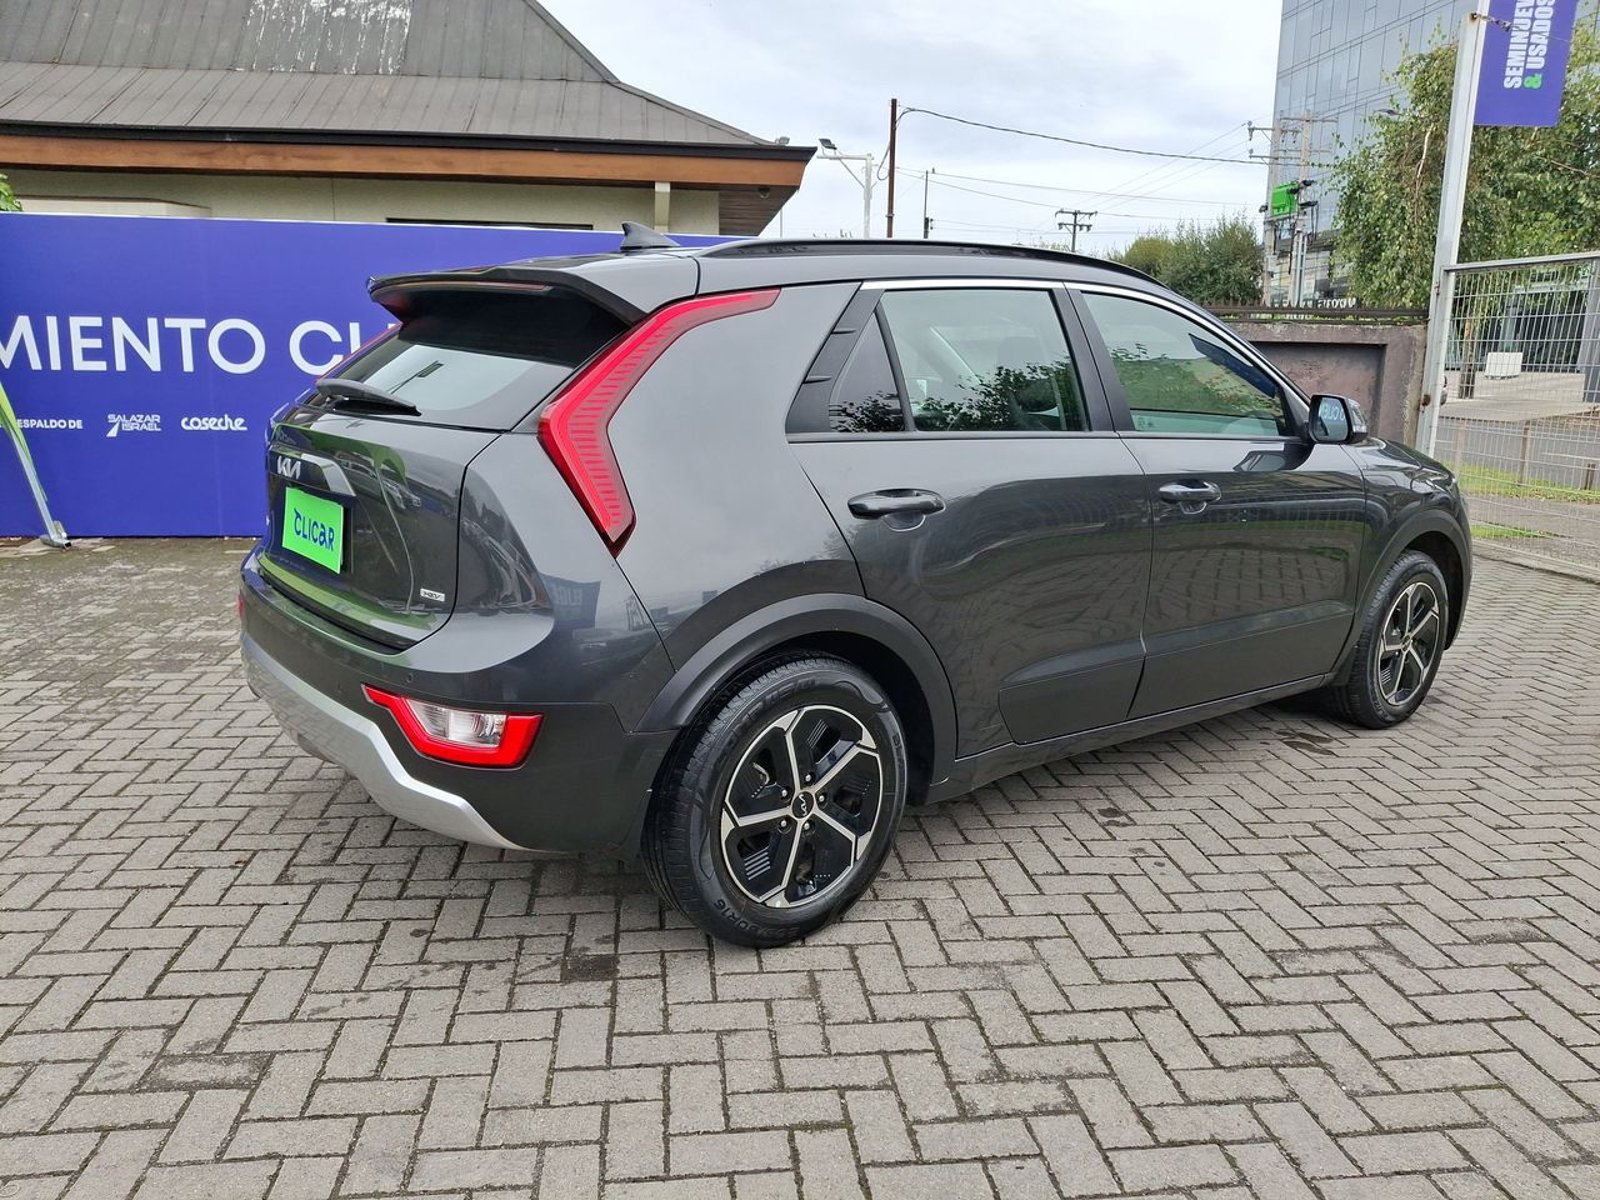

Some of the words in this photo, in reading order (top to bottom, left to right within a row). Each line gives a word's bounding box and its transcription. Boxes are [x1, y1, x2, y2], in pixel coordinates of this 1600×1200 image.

[107, 414, 161, 423] SALAZAR
[181, 413, 248, 431] coseche
[17, 419, 67, 429] ESPALDO
[68, 419, 84, 429] DE
[122, 423, 162, 431] ISRAEL
